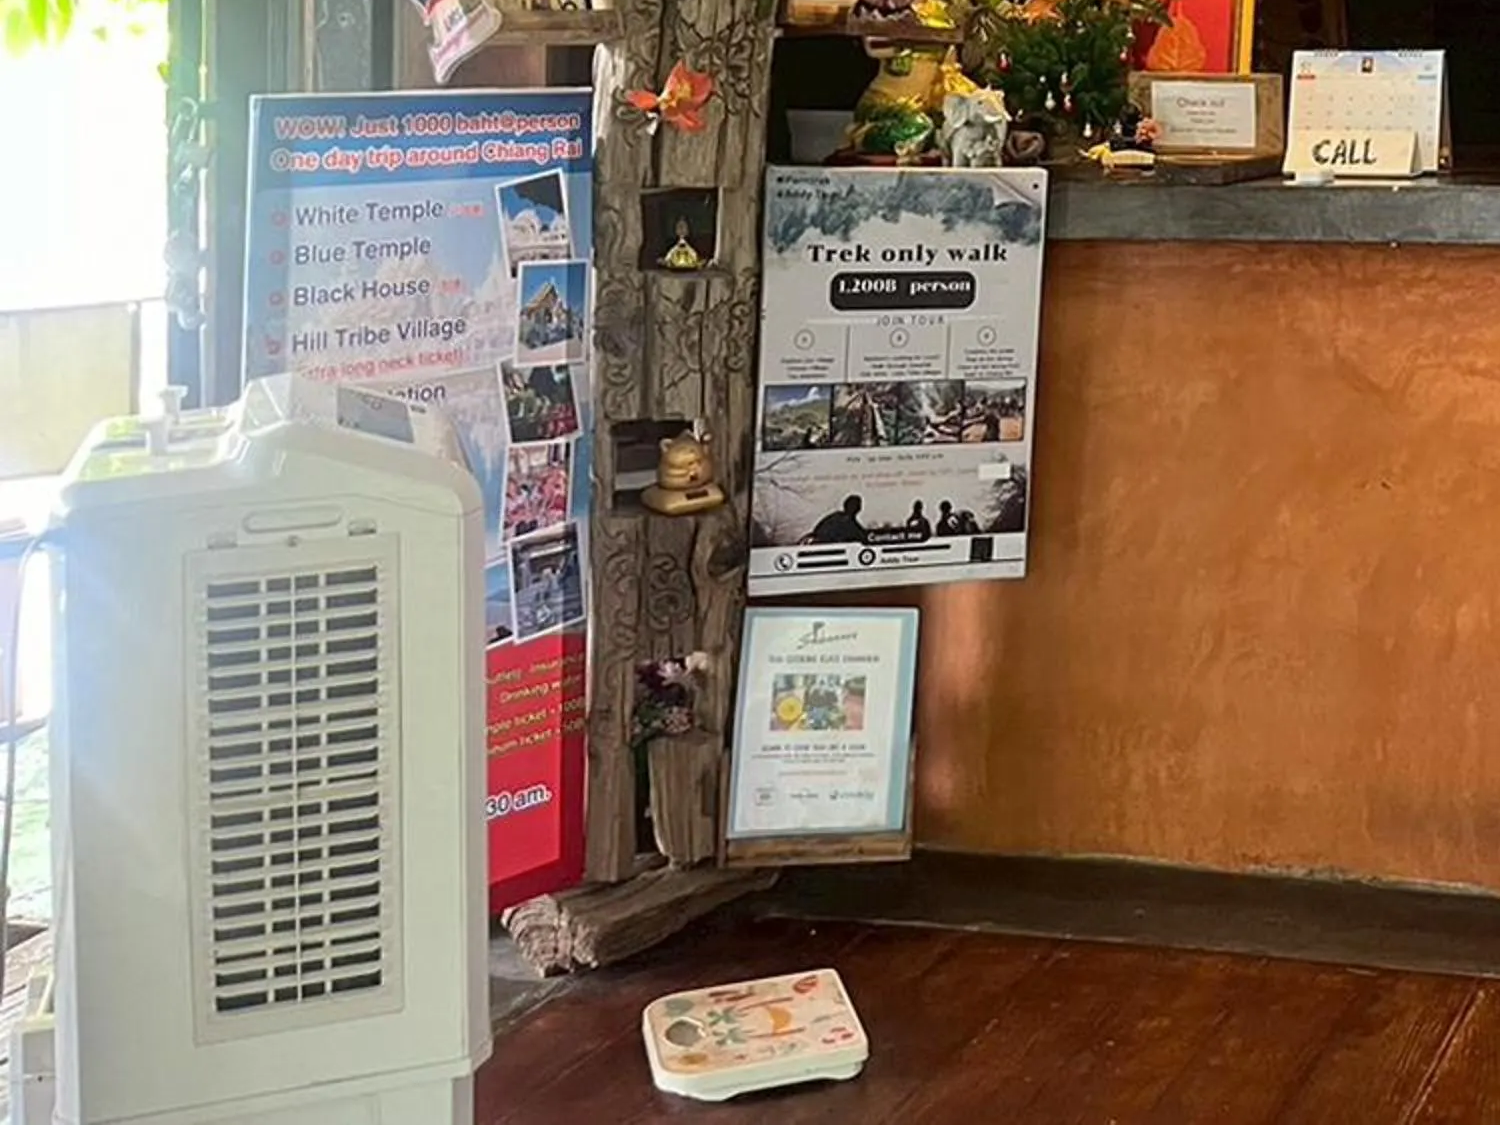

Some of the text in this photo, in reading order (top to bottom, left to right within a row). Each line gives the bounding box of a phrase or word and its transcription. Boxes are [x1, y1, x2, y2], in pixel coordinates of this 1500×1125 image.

[350, 114, 399, 138] Just
[402, 113, 452, 136] 1000
[270, 137, 583, 173] One day trip around Chiang Rai
[1312, 138, 1377, 165] CALL
[295, 205, 360, 226] White
[365, 199, 444, 223] Temple
[294, 236, 432, 266] Blue Temple
[807, 242, 1008, 266] Trek only walk
[293, 282, 355, 307] Black
[362, 279, 431, 300] House
[909, 280, 971, 296] person
[291, 317, 467, 353] Hill Tribe Village
